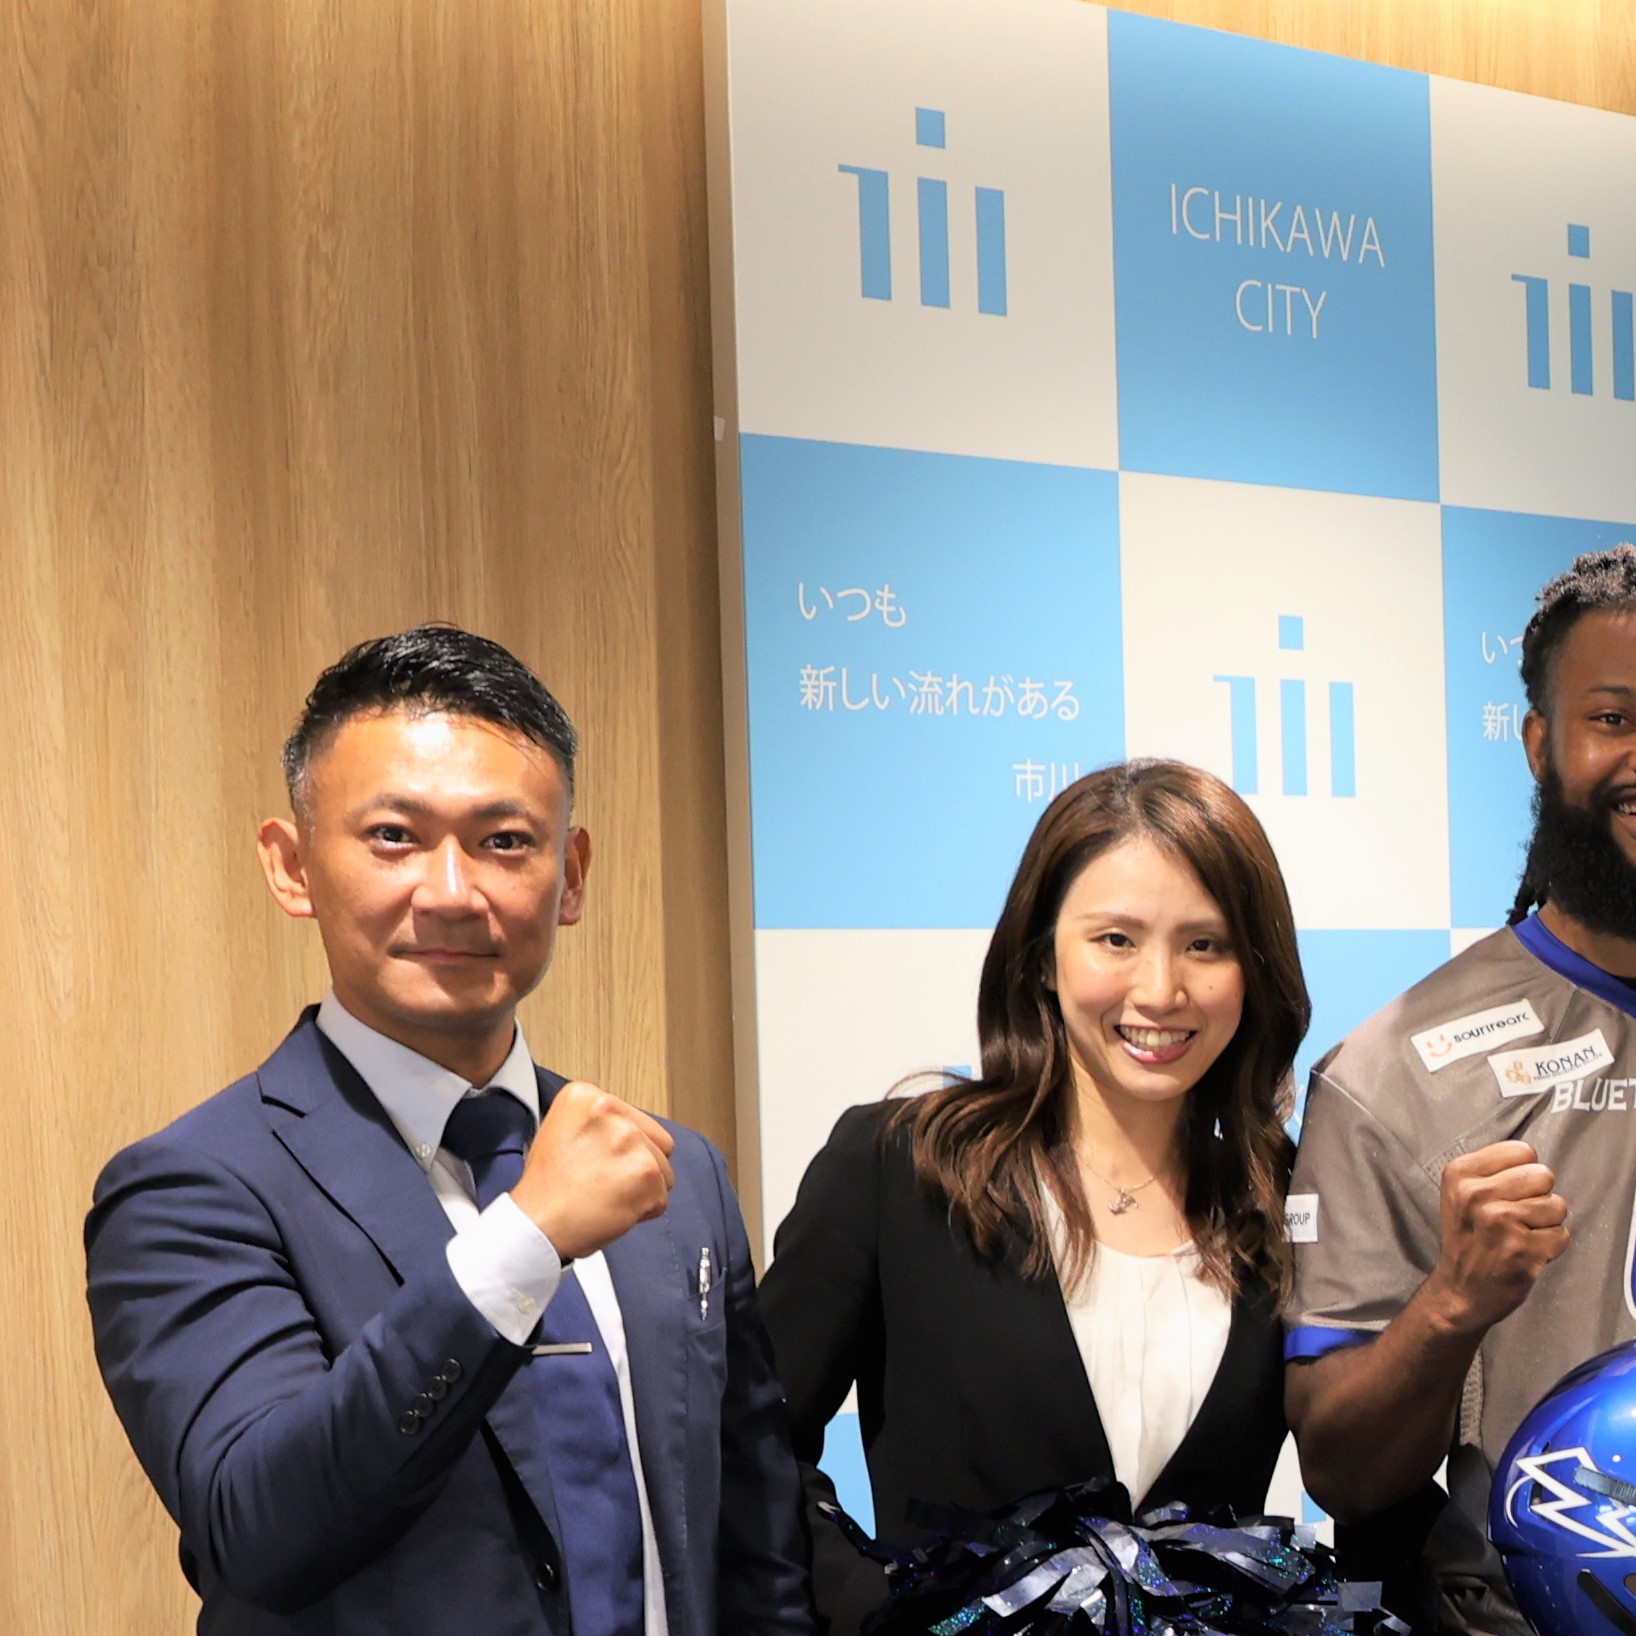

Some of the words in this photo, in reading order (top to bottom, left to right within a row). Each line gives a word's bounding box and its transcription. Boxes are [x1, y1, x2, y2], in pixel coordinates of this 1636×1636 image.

[1169, 182, 1386, 268] ICHIKAWA
[1233, 278, 1328, 339] CITY
[798, 582, 907, 628] いつも
[799, 664, 1081, 722] 新しい流れがある
[1534, 1045, 1598, 1077] KONAN
